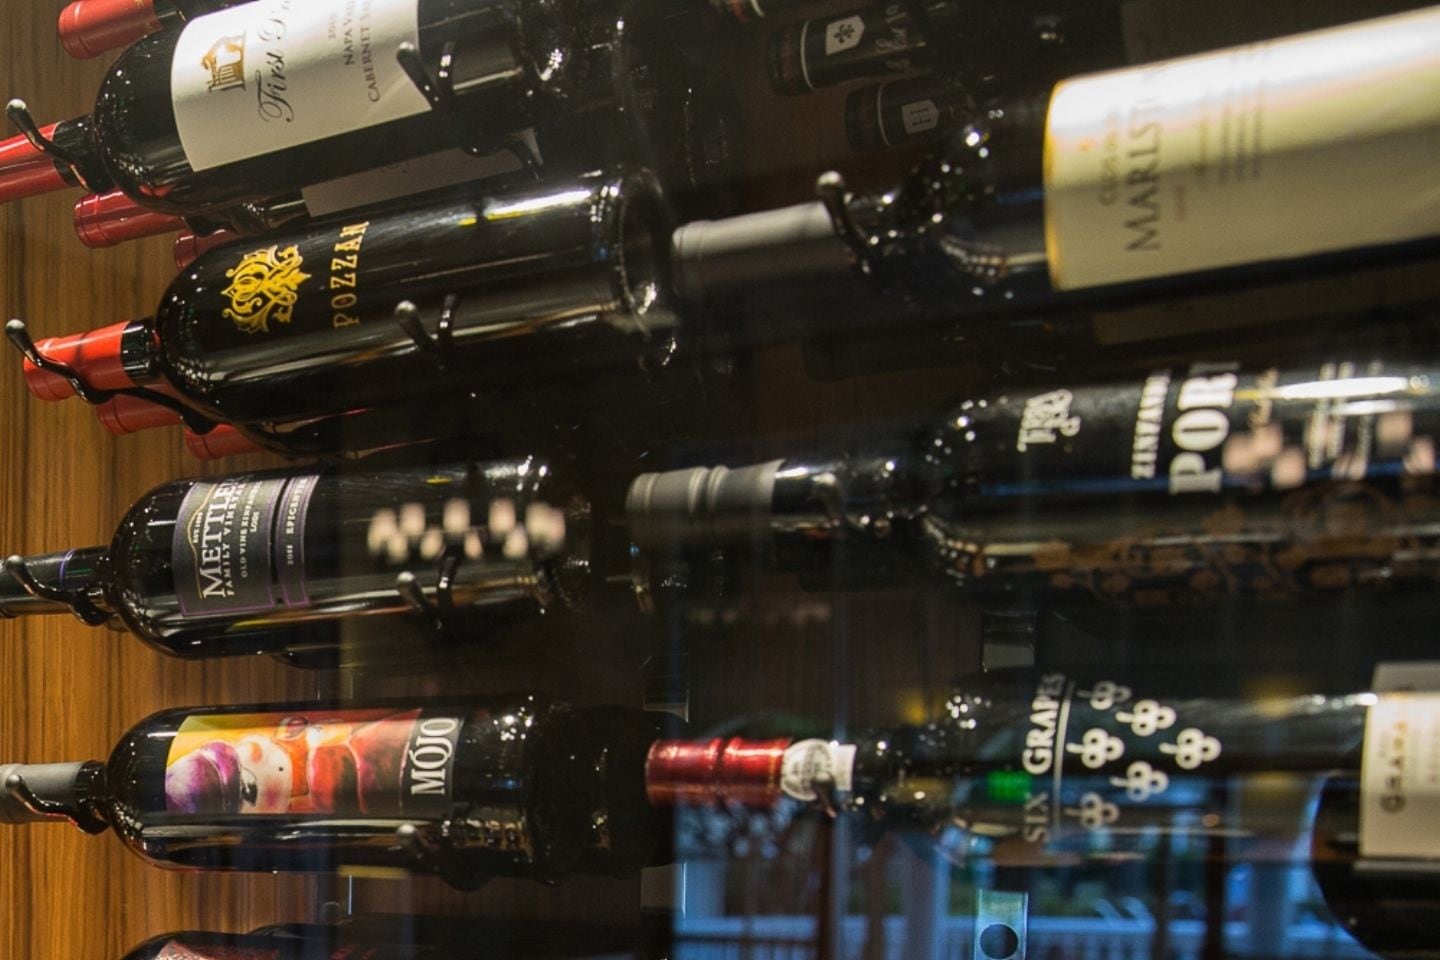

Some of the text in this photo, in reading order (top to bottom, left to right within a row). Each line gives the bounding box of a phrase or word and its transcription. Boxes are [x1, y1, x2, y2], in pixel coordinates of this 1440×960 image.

[343, 29, 354, 66] NAPA
[360, 26, 380, 103] CABERNET
[255, 51, 294, 122] First
[330, 219, 370, 329] POZZAN
[222, 543, 235, 596] FAMILY
[240, 557, 248, 578] OLD
